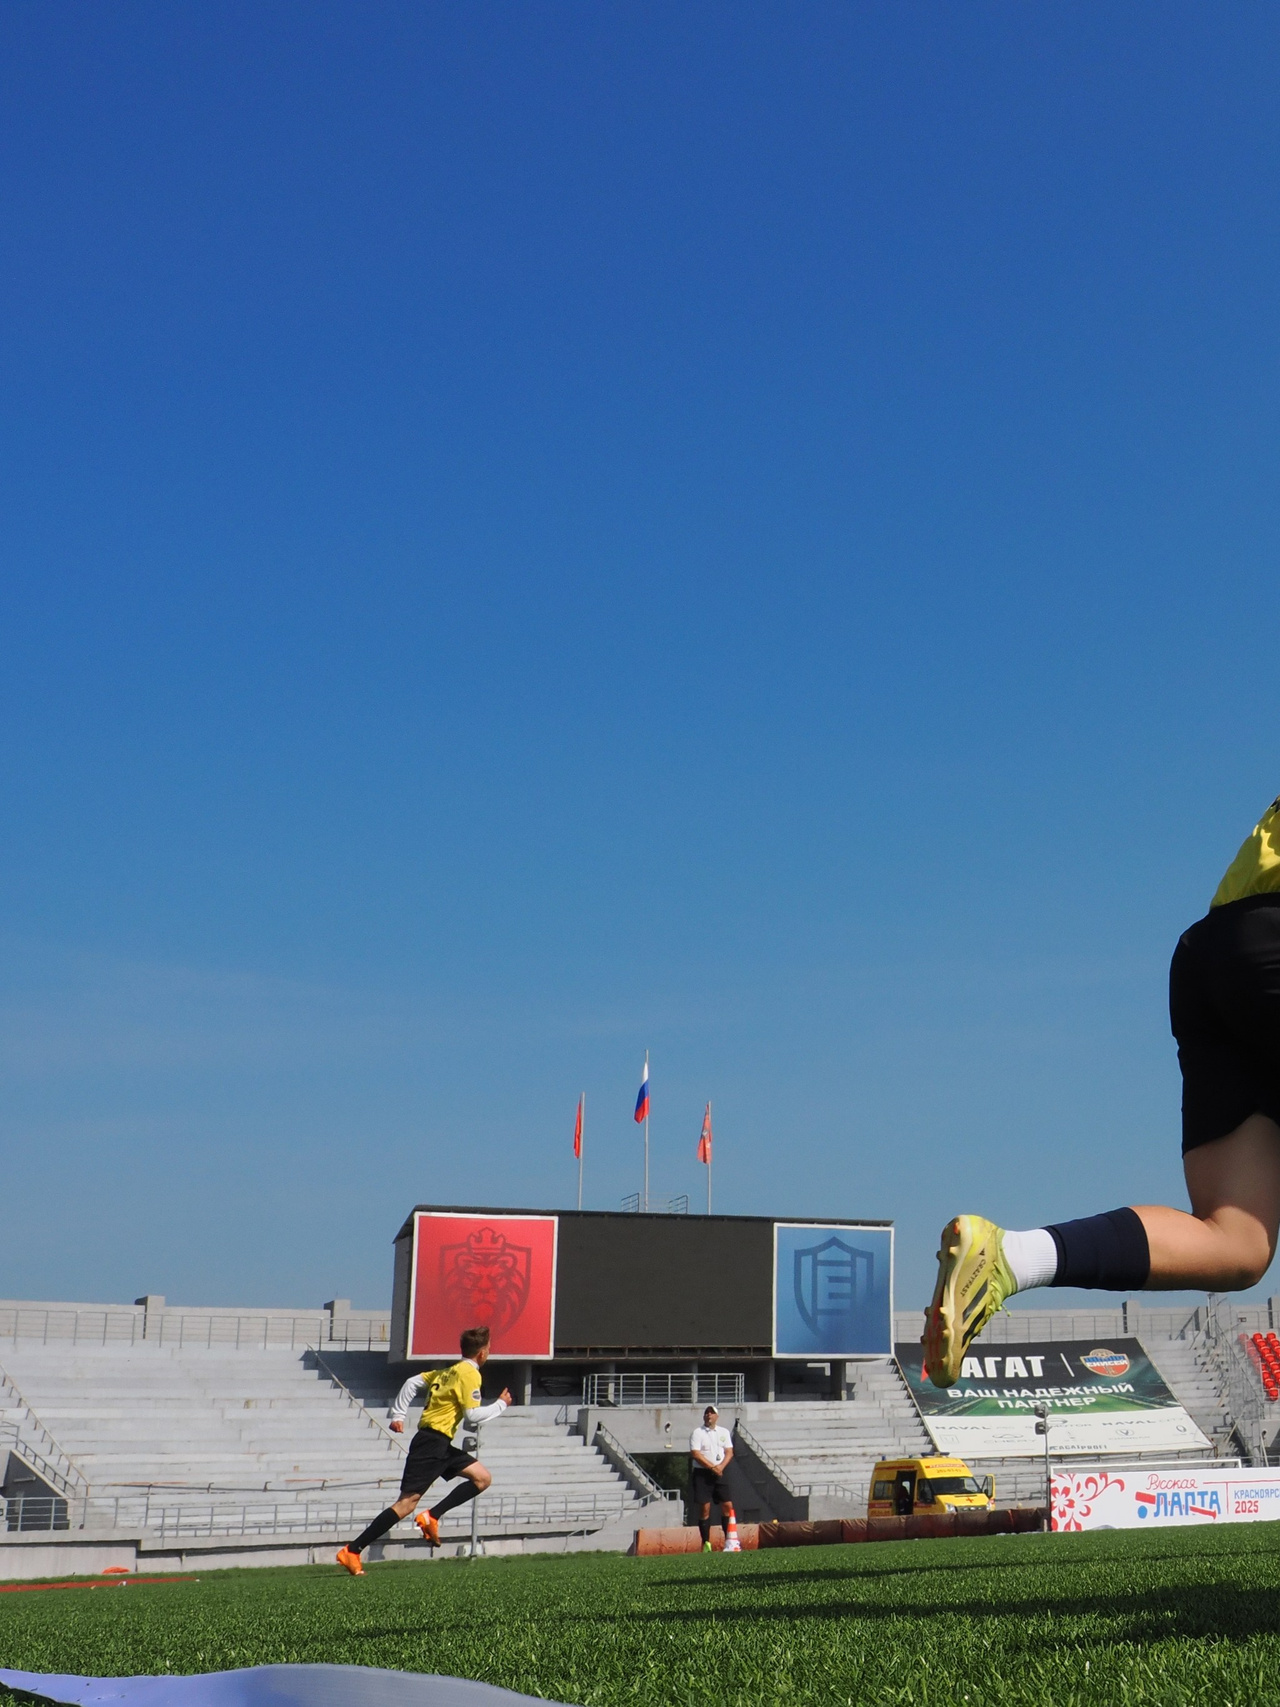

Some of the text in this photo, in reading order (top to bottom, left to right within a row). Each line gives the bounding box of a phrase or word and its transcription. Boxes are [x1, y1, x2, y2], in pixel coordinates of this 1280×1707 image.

[961, 1356, 1045, 1378] АГАТ
[947, 1383, 1135, 1399] ВАШ НАДЕЖНЫЙ
[997, 1397, 1097, 1409] ПАРТНЕР
[1146, 1473, 1198, 1490] Русская
[1154, 1490, 1221, 1517] ЛАПТА
[1235, 1500, 1259, 1513] 2025
